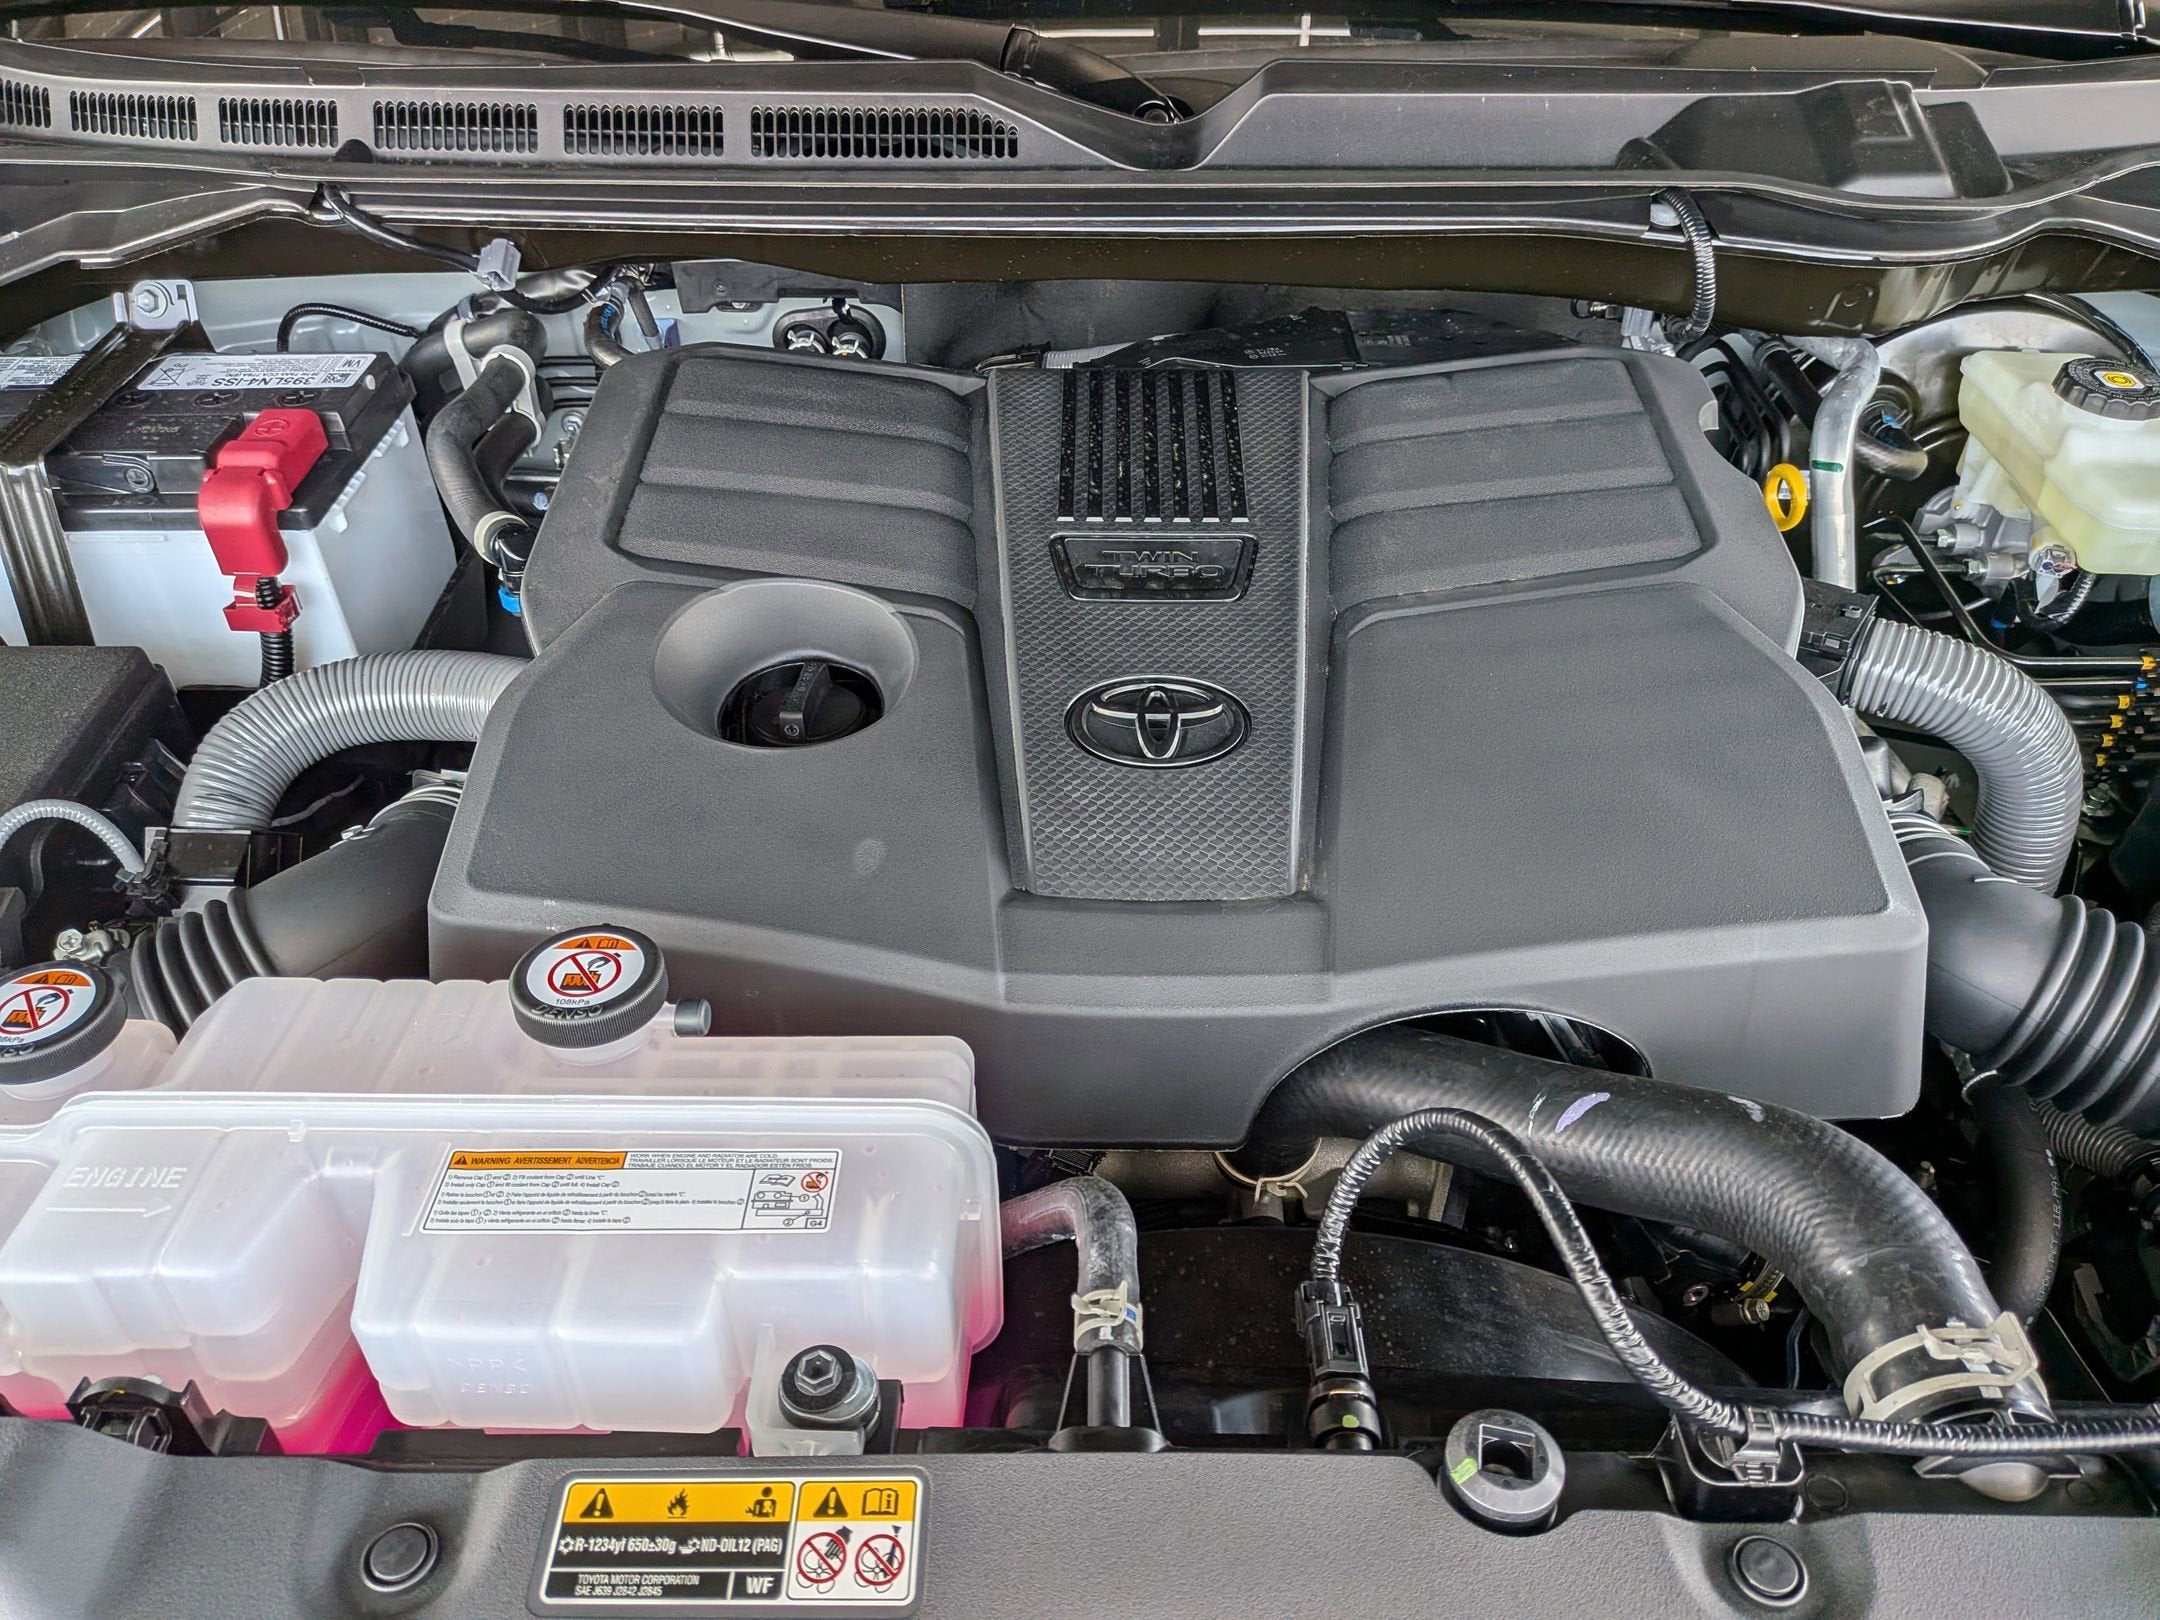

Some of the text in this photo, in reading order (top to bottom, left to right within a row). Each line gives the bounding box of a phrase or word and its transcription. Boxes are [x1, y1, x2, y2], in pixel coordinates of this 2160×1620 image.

[1102, 550, 1199, 562] TWIN
[1084, 564, 1226, 578] TURBO
[555, 998, 590, 1006] 108kPa
[531, 1004, 604, 1020] DENSO
[470, 1157, 620, 1165] WARNING AVERTISSEMENT ADVERTENCIA
[62, 1166, 188, 1188] ENGINE
[574, 1536, 783, 1556] R-1234yf 650±30g ND-OIL12 (PAG)
[578, 1574, 700, 1585] TOYOTA MOTOR CORPORATION
[746, 1576, 775, 1594] WF
[575, 1586, 591, 1596] SAE
